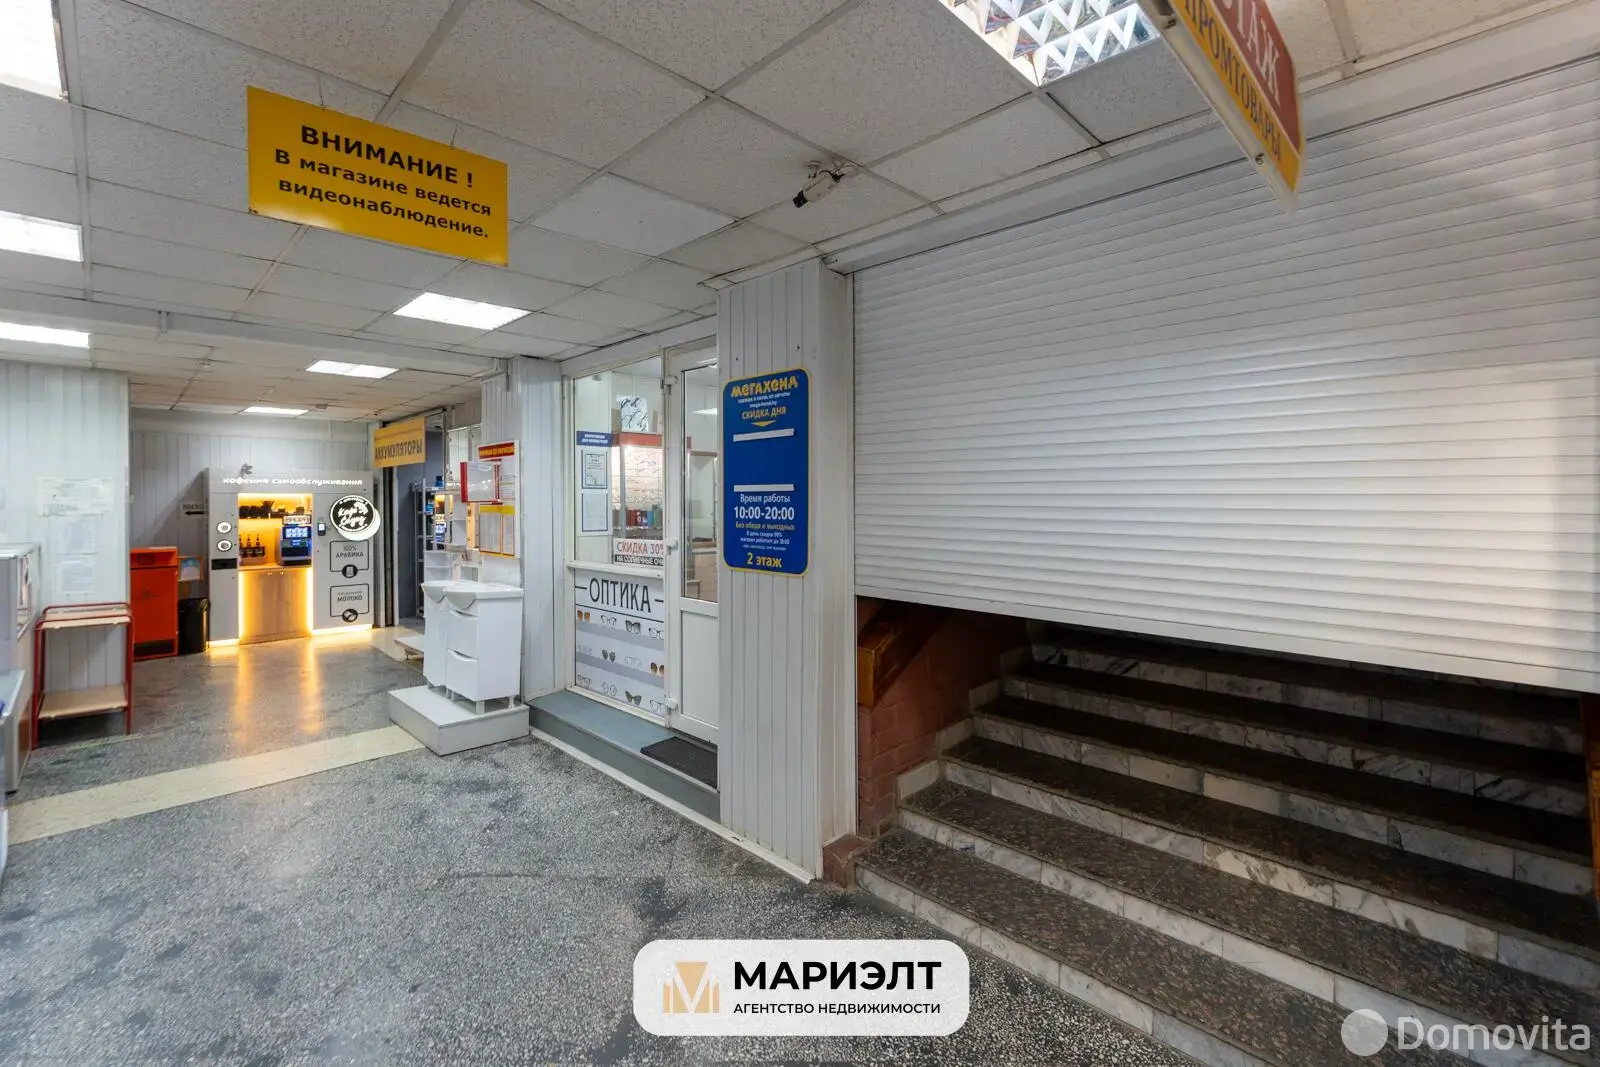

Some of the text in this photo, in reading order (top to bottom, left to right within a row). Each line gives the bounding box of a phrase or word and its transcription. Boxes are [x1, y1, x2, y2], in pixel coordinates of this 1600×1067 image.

[1221, 0, 1280, 107] ТАЖ
[301, 125, 473, 188] ВНИМАНИЕ !
[275, 149, 491, 216] В магазине ведется
[278, 179, 489, 238] видеонаблюдение.
[742, 406, 787, 420] СКИДКА ДНЯ
[374, 437, 423, 460] АККУМУЛЯТОРЫ
[223, 476, 363, 487] кофейня самообслуживания
[740, 493, 791, 505] Время работы
[734, 506, 795, 520] 10:00-20:00
[616, 542, 648, 554] СКИДКА
[624, 556, 654, 566] СОЛНЕЧНЫЕ
[747, 552, 782, 567] 2 этаж
[337, 594, 363, 602] МОЛОКО
[589, 577, 652, 613] ОПТИКА
